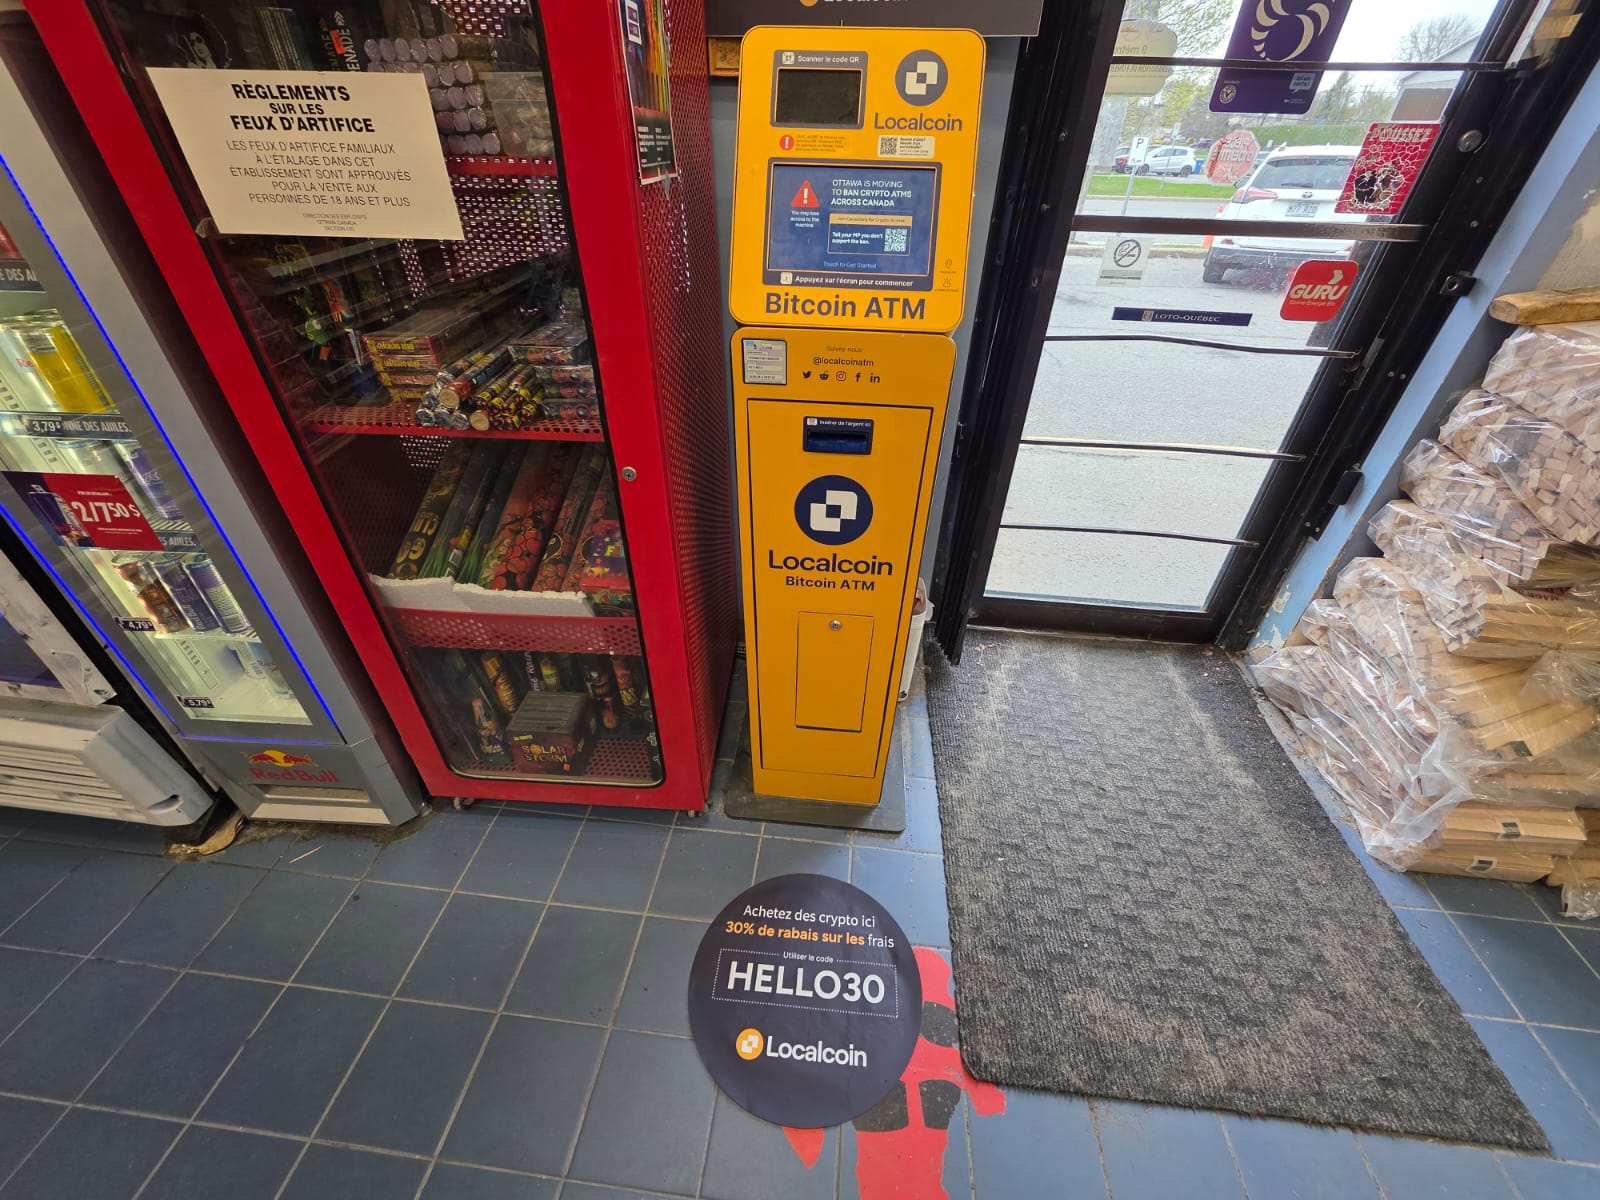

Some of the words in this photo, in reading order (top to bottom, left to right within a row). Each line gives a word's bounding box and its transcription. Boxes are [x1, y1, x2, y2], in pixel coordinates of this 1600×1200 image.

[798, 55, 824, 63] Scanner
[825, 55, 831, 63] le
[231, 80, 351, 101] RÈGLEMENTS
[269, 103, 296, 114] SUR
[299, 104, 325, 115] LES
[230, 115, 277, 130] FEUX
[280, 116, 375, 133] D'ARTIFICE
[874, 113, 963, 132] Localcoin
[226, 140, 247, 151] LES
[249, 141, 277, 151] FEUX
[279, 142, 337, 153] D'ARTIFICE
[340, 143, 395, 154] FAMILIAUX
[1136, 138, 1144, 149] P
[256, 153, 264, 164] À
[266, 154, 320, 165] L'ÉTALAGE
[323, 156, 351, 166] DANS
[354, 157, 375, 167] CET
[229, 167, 312, 179] ÉTABLISSEMENT
[316, 169, 344, 179] SONT
[347, 169, 411, 181] APPROUVÉS
[272, 181, 300, 191] POUR
[303, 182, 317, 192] LA
[319, 182, 354, 193] VENTE
[356, 184, 378, 193] AUX
[248, 193, 311, 204] PERSONNES
[313, 195, 328, 205] DE
[331, 195, 342, 205] 18
[345, 195, 366, 206] ANS
[368, 196, 381, 206] ET
[383, 197, 411, 207] PLUS
[831, 198, 861, 206] ACROSS
[862, 199, 895, 207] CANADA
[795, 276, 824, 285] Appuyez
[1289, 284, 1349, 300] GURU
[765, 292, 856, 317] Bitcoin
[864, 297, 926, 320] ATM
[813, 356, 874, 367] @localcoinatm
[83, 421, 99, 432] DES
[768, 550, 893, 576] Localcoin
[785, 575, 836, 589] Bitcoin
[840, 579, 875, 591] ATM
[743, 905, 792, 920] Achetez
[794, 909, 816, 922] des
[818, 914, 859, 928] crypto
[861, 915, 876, 928] ici
[725, 920, 754, 935] 30%
[757, 924, 775, 937] de
[778, 927, 819, 942] rabais
[822, 933, 843, 944] sur
[846, 932, 865, 946] les
[867, 934, 895, 948] frais
[783, 951, 807, 961] Utiliser
[808, 953, 815, 961] le
[816, 955, 834, 964] code
[727, 961, 885, 1004] HELLO30
[766, 1036, 867, 1068] Localcoin
